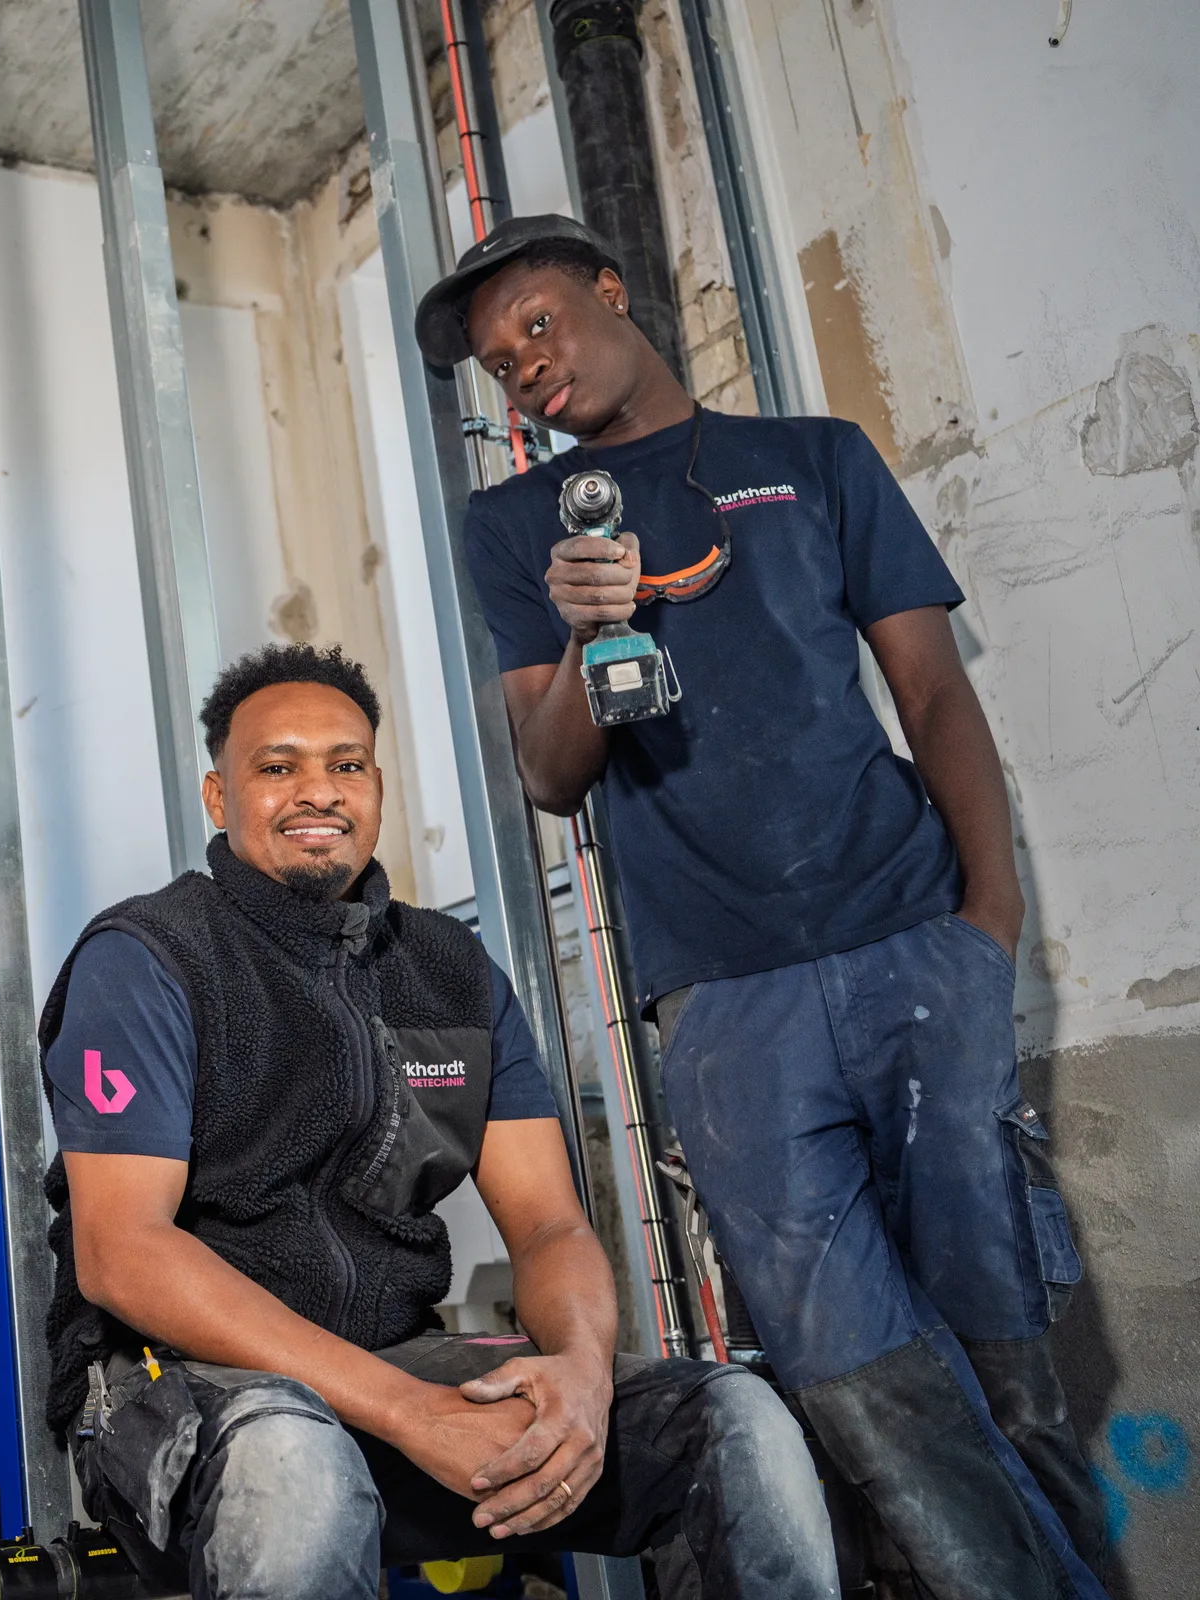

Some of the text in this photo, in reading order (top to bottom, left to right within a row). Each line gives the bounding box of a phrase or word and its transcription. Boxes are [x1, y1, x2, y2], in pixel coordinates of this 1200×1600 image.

[402, 1060, 466, 1077] khardt
[83, 1049, 138, 1115] b
[407, 1077, 466, 1088] DETECHNIK
